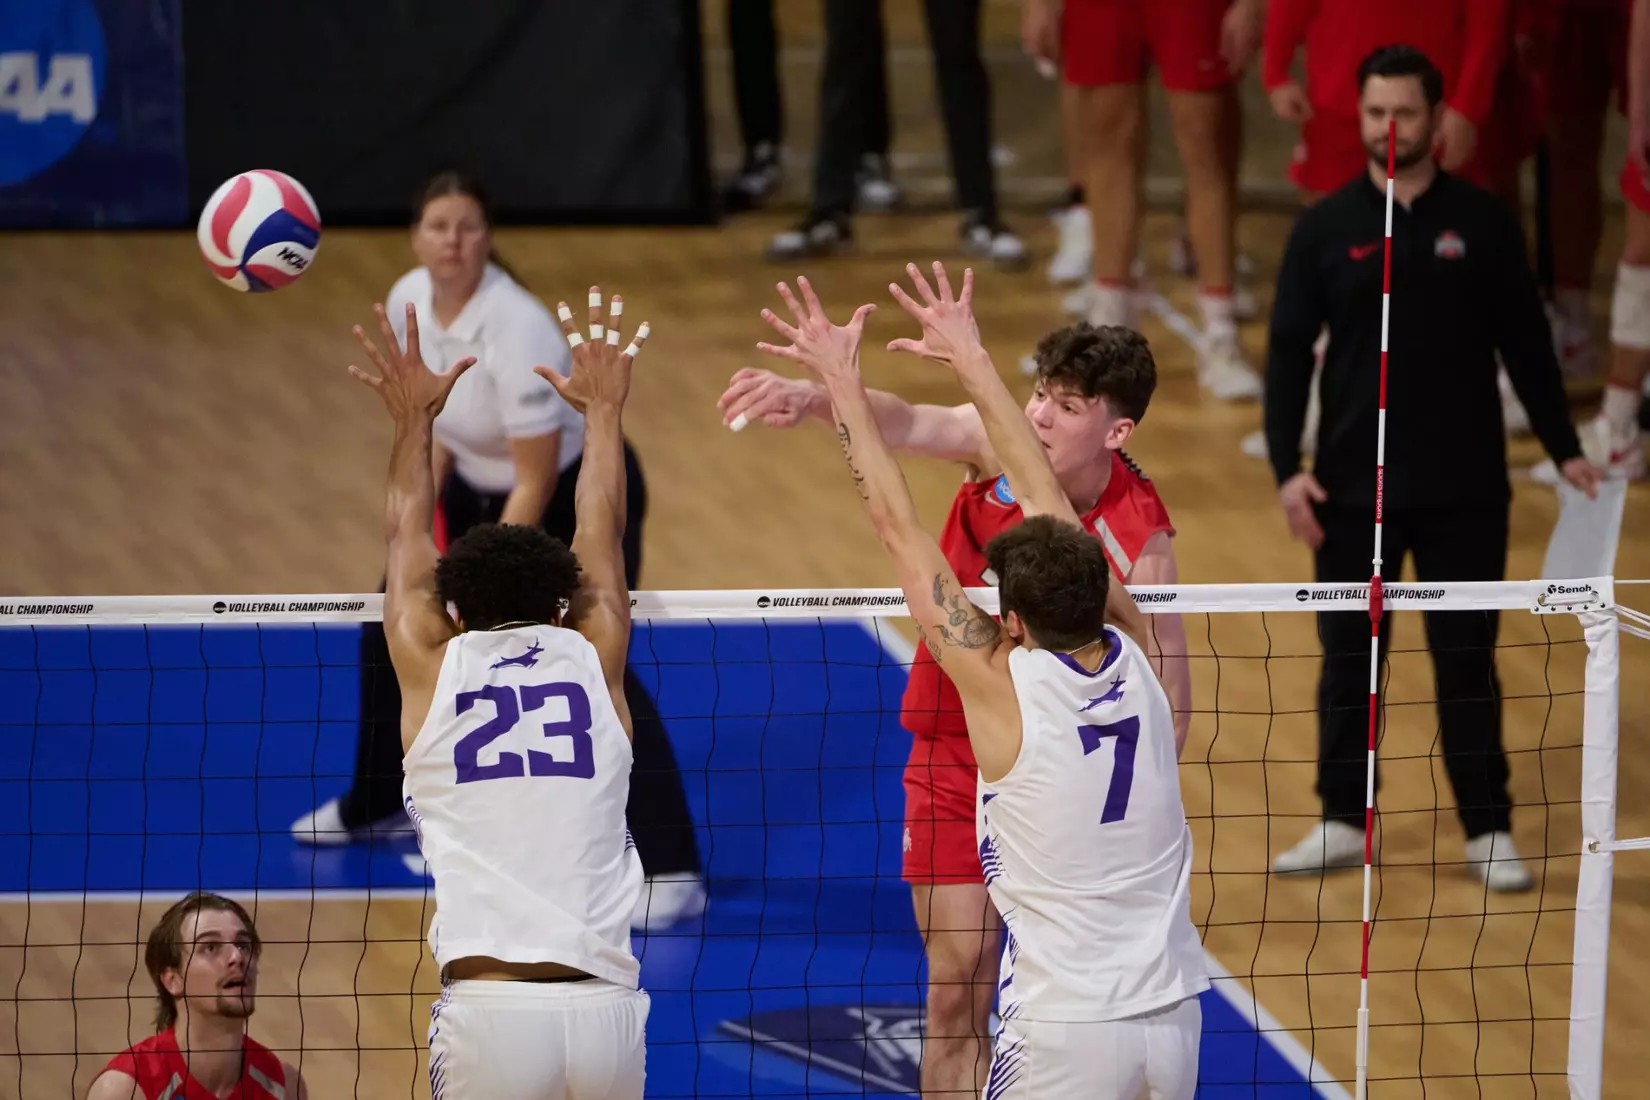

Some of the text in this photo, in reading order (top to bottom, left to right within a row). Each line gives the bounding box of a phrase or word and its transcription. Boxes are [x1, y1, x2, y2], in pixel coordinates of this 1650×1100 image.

[0, 51, 97, 124] AA
[1311, 590, 1367, 600] VOLLEYBALL
[1383, 589, 1446, 600] AMPIONSHIP
[1557, 584, 1592, 594] Senoh
[772, 597, 830, 607] VOLLEYBALL
[1131, 593, 1177, 603] PIONSHIP
[17, 604, 94, 614] CHAMPIONSHIP
[228, 602, 286, 612] VOLLEYBALL
[288, 601, 365, 612] CHAMPIONSHIP
[454, 681, 596, 785] 23
[1077, 714, 1140, 825] 7
